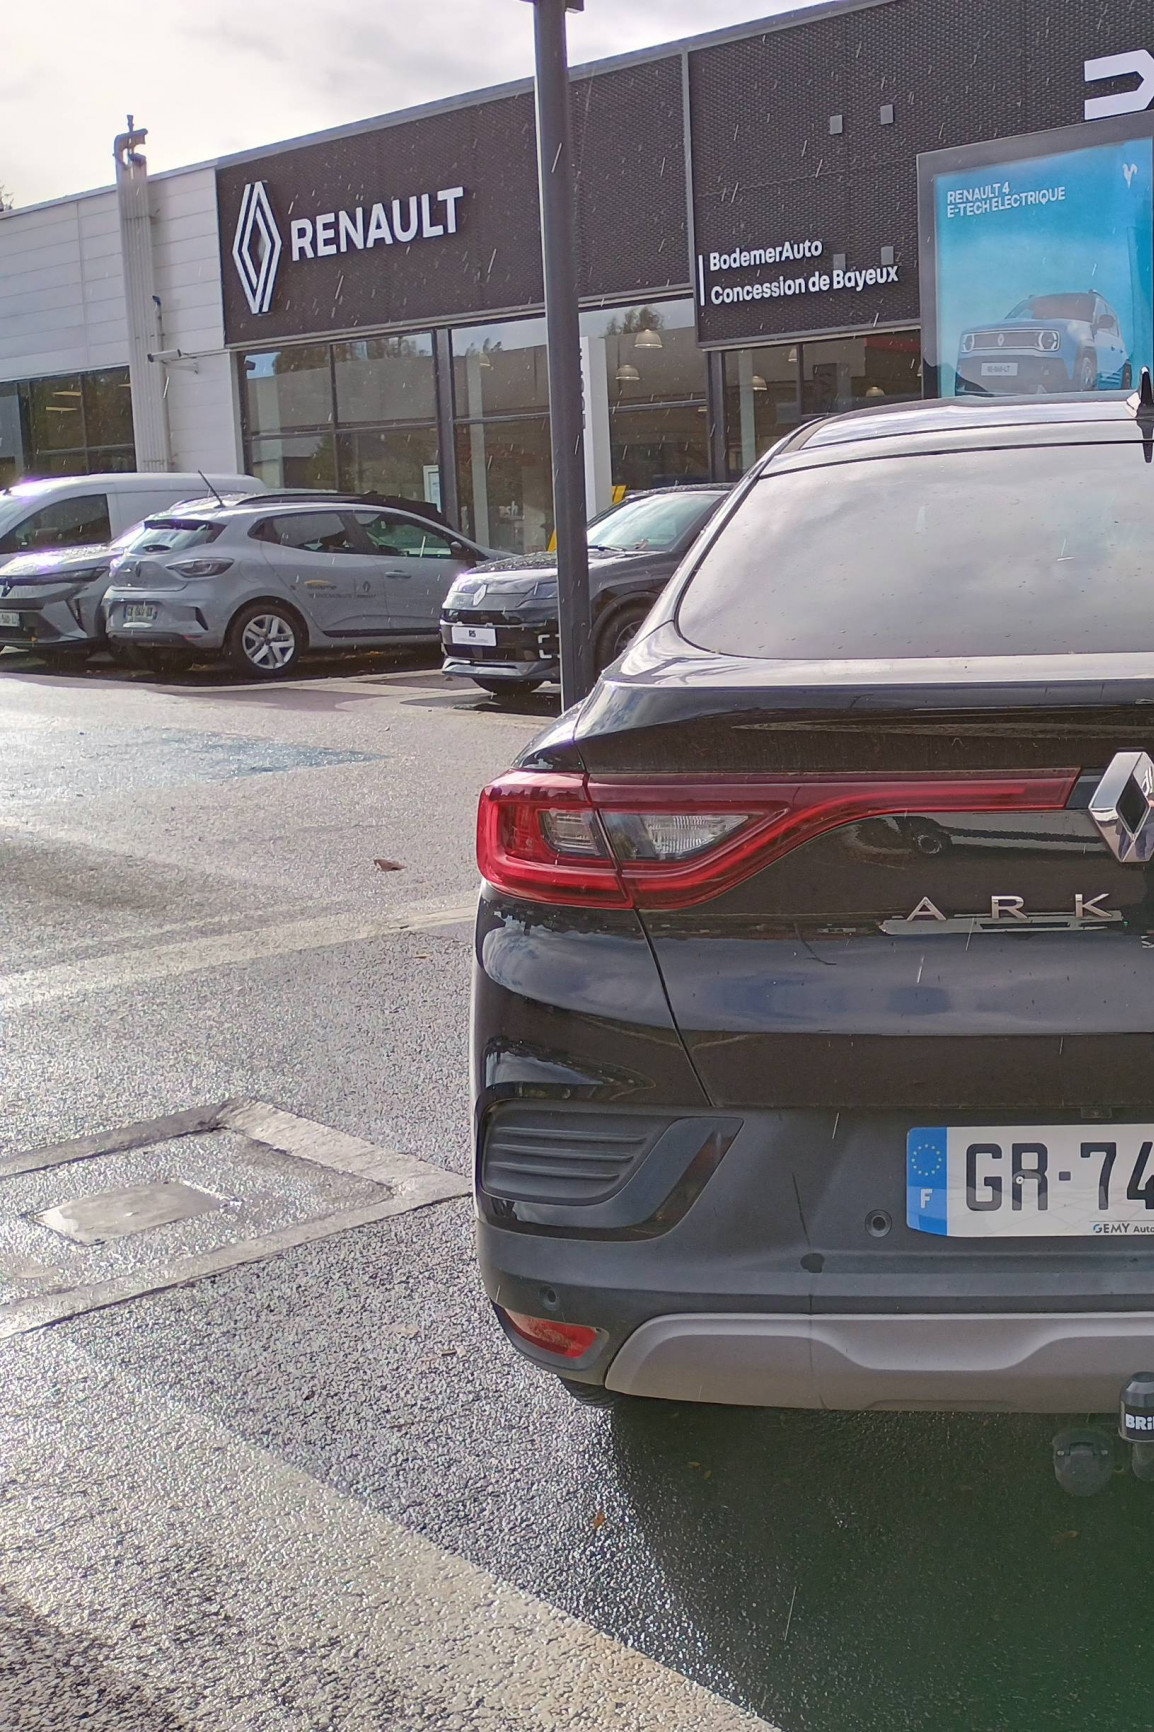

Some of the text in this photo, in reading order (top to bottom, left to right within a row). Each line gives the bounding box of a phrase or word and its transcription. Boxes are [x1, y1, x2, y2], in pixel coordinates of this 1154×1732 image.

[947, 181, 1011, 205] RENAULT 4
[947, 201, 990, 219] E-TECH
[290, 186, 464, 262] RENAULT
[709, 239, 823, 271] BodemerAuto
[710, 265, 899, 305] Concession de Bayeux
[920, 1188, 933, 1209] F
[1093, 1222, 1130, 1234] GEMY
